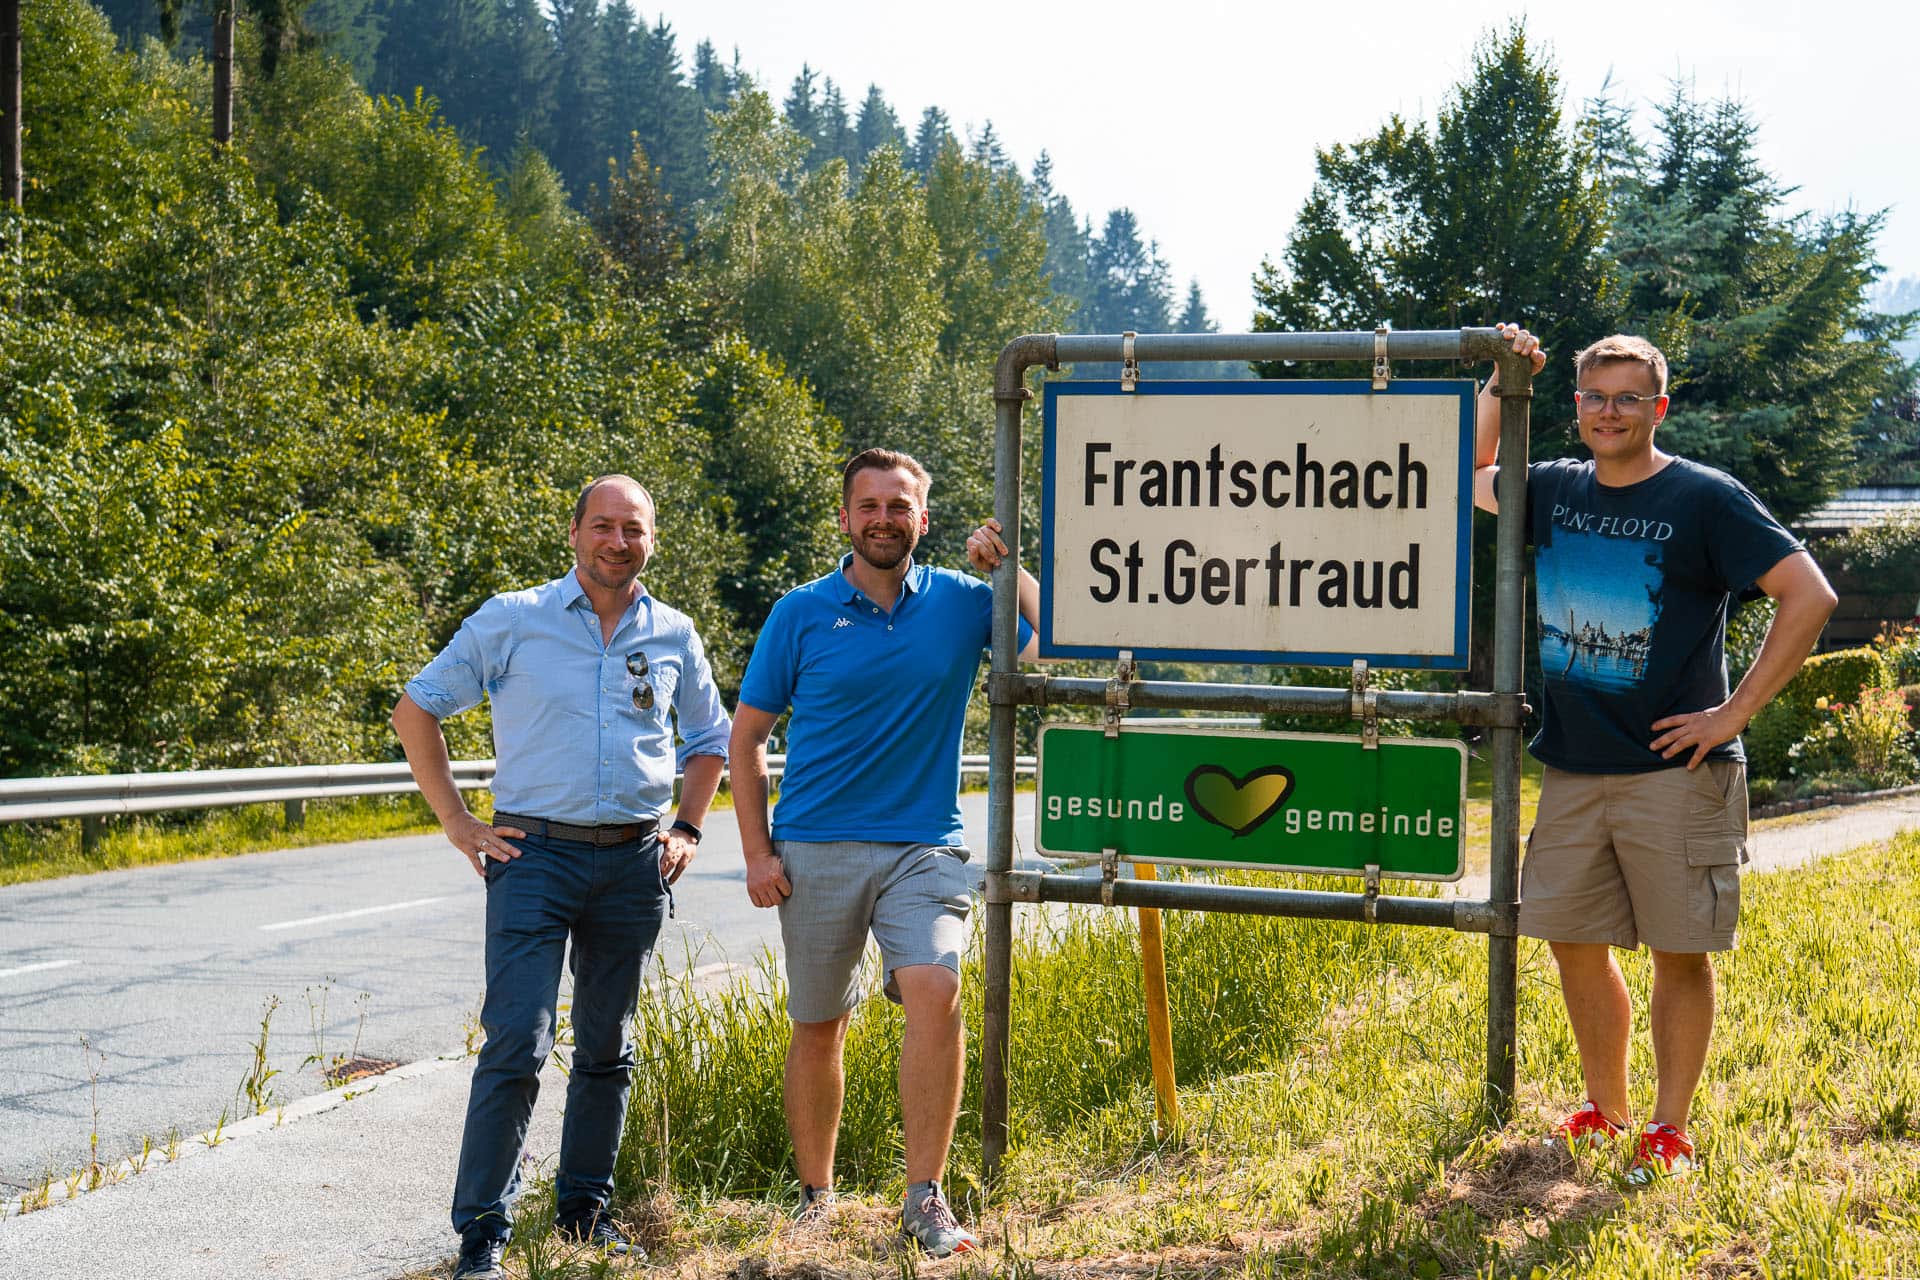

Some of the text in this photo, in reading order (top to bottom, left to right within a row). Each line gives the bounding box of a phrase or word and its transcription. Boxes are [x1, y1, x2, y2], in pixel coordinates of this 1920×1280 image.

[1085, 442, 1428, 509] Frantschach
[1597, 516, 1673, 541] FLOYD
[1089, 538, 1420, 609] St.Gertraud
[1047, 795, 1184, 822] gesunde
[1285, 807, 1454, 838] gemeinde
